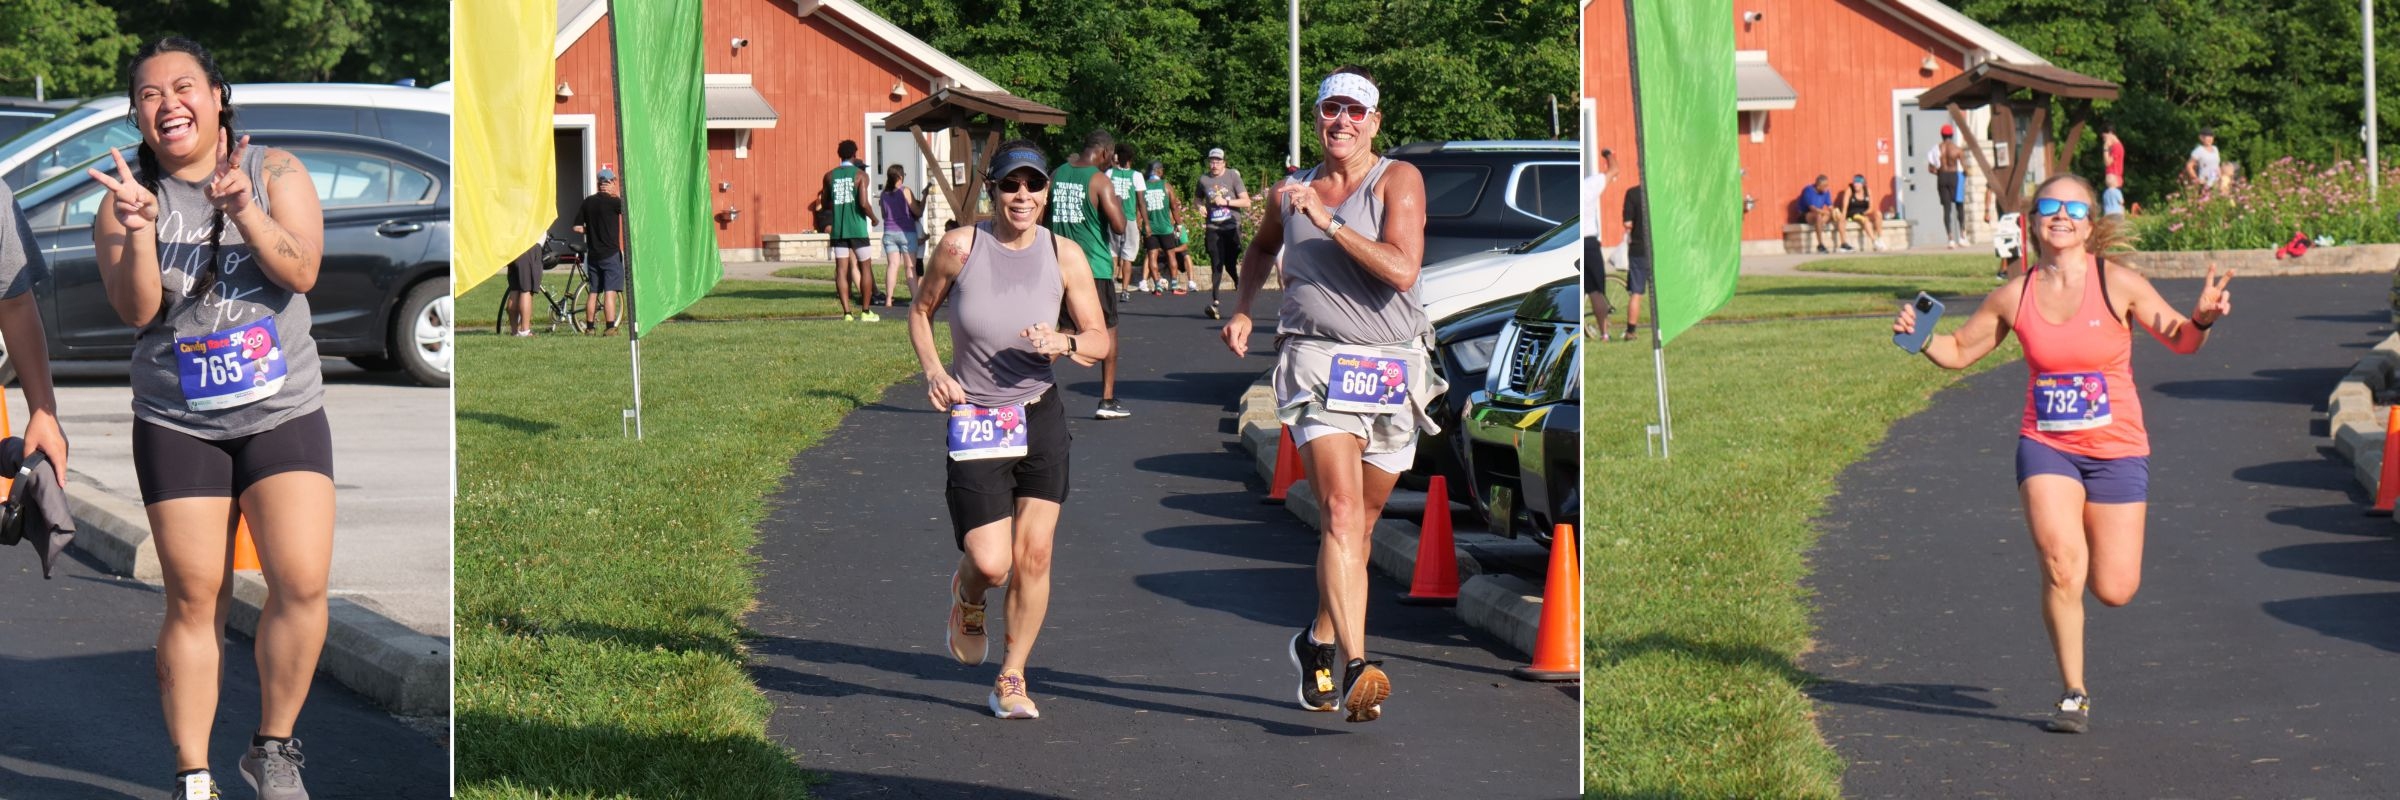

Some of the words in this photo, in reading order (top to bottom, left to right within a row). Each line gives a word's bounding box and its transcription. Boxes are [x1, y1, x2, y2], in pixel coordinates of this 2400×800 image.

[180, 341, 207, 353] Candy
[229, 331, 247, 347] 5K
[193, 352, 243, 388] 765
[1342, 370, 1378, 396] 660
[2043, 389, 2078, 414] 732
[958, 419, 994, 443] 729
